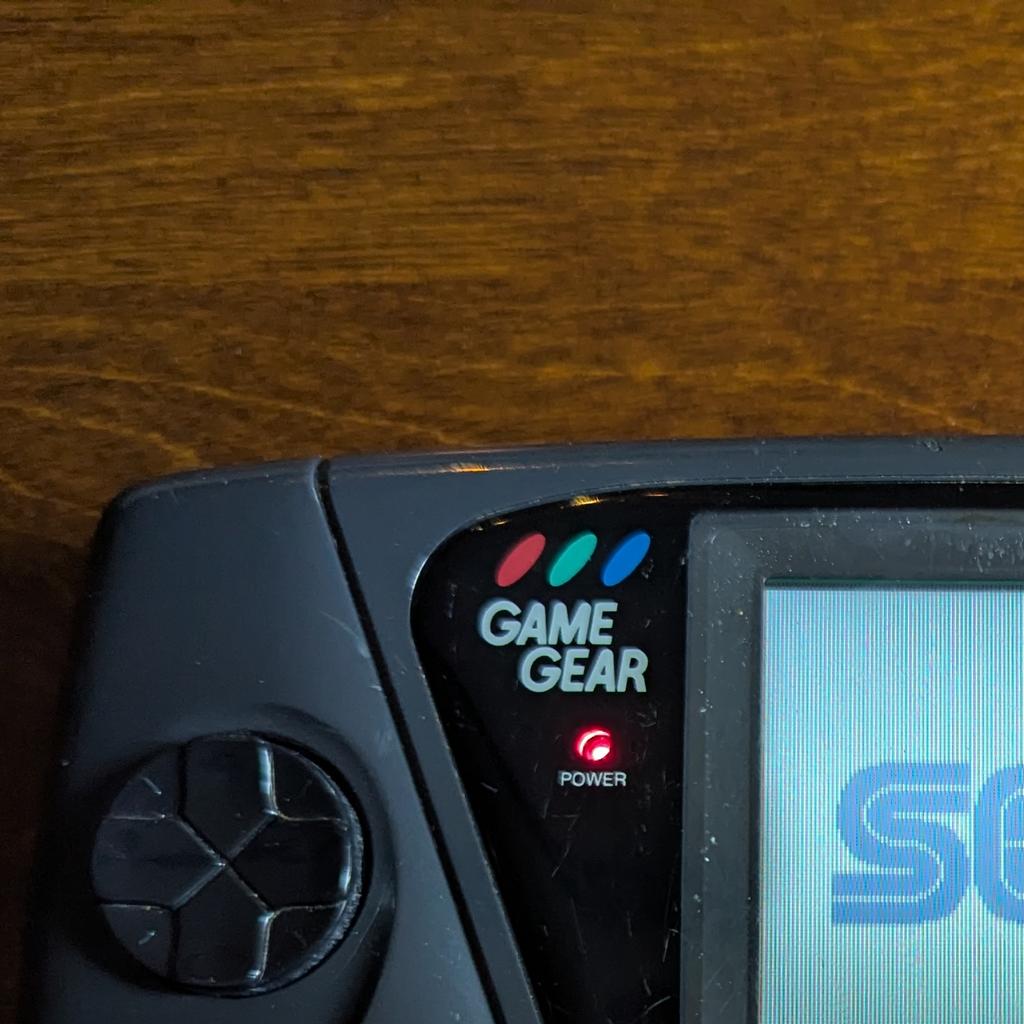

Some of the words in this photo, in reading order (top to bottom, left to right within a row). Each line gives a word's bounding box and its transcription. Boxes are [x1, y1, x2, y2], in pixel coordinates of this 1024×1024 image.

[478, 598, 618, 647] GAME
[518, 646, 649, 693] GEAR
[559, 771, 628, 787] POWER
